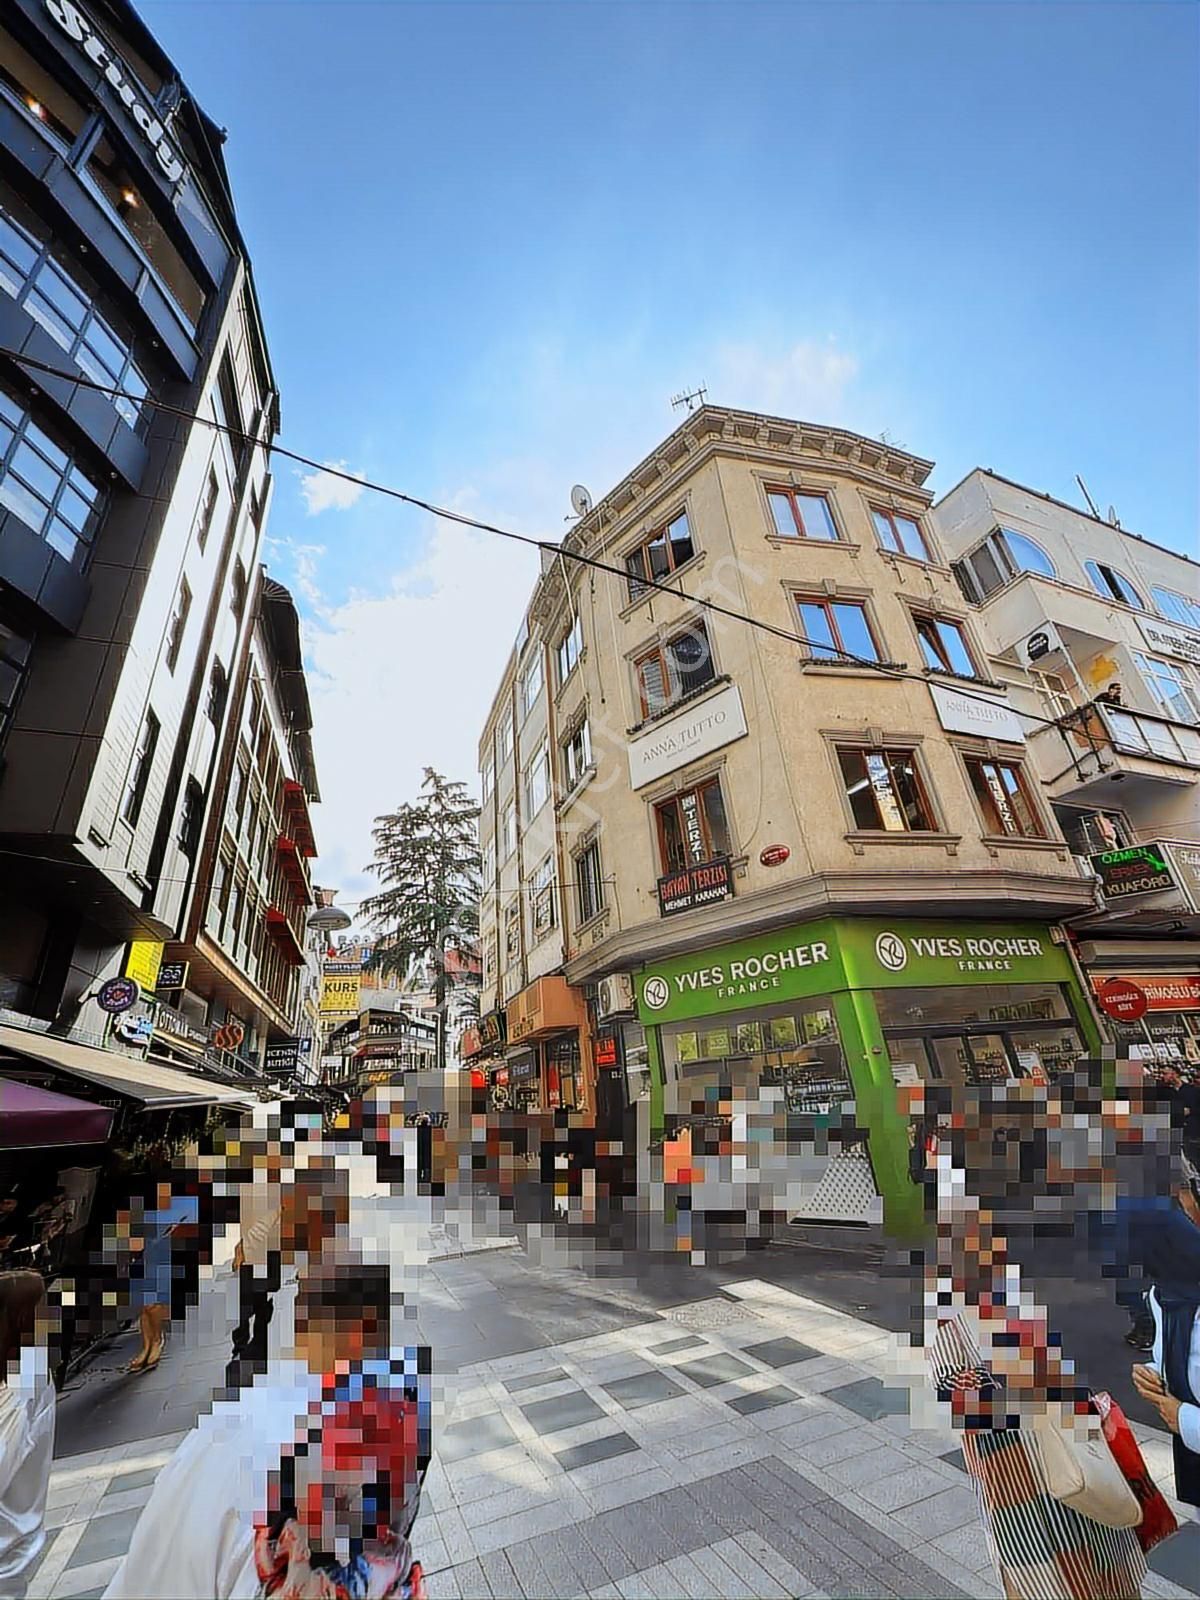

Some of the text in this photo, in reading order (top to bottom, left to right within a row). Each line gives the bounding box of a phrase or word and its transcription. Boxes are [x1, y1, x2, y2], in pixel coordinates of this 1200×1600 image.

[680, 711, 726, 742] TUTTO
[661, 874, 690, 900] BAYAN
[664, 885, 728, 911] MEHMET KARAHAN
[910, 938, 1043, 957] YVES ROCHER
[675, 942, 829, 992] YVES ROCHER
[959, 960, 1012, 971] FRANCE
[324, 982, 358, 993] KURS
[718, 977, 781, 998] FRANCE
